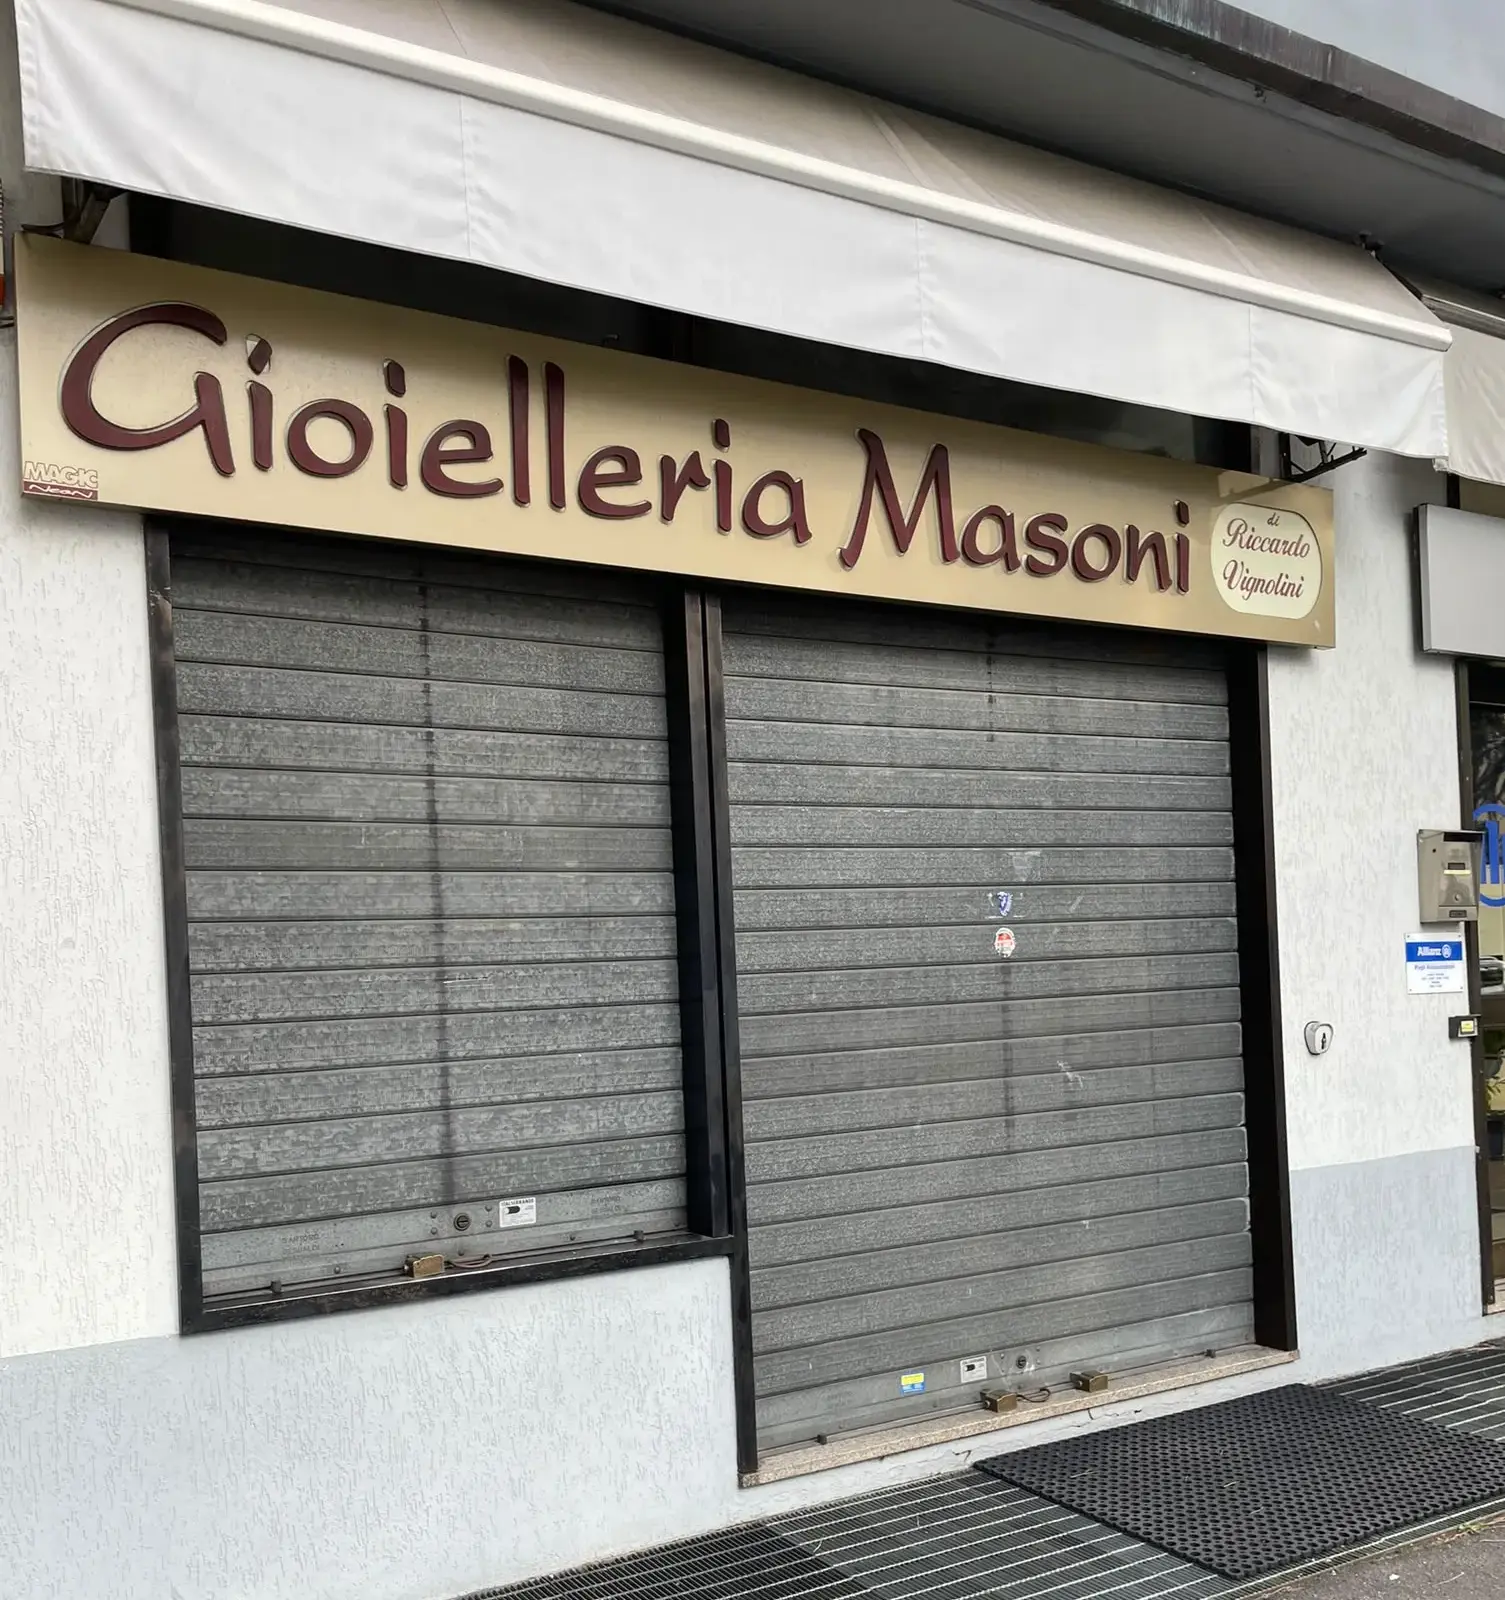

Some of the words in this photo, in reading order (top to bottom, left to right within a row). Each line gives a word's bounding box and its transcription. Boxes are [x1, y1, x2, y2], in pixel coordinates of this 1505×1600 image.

[60, 301, 813, 545] Gioielleria
[838, 427, 1192, 597] Masoni
[24, 461, 99, 489] MAGIC
[1222, 517, 1311, 559] Riccardo
[1266, 512, 1281, 527] di
[1222, 559, 1305, 601] Vignolini
